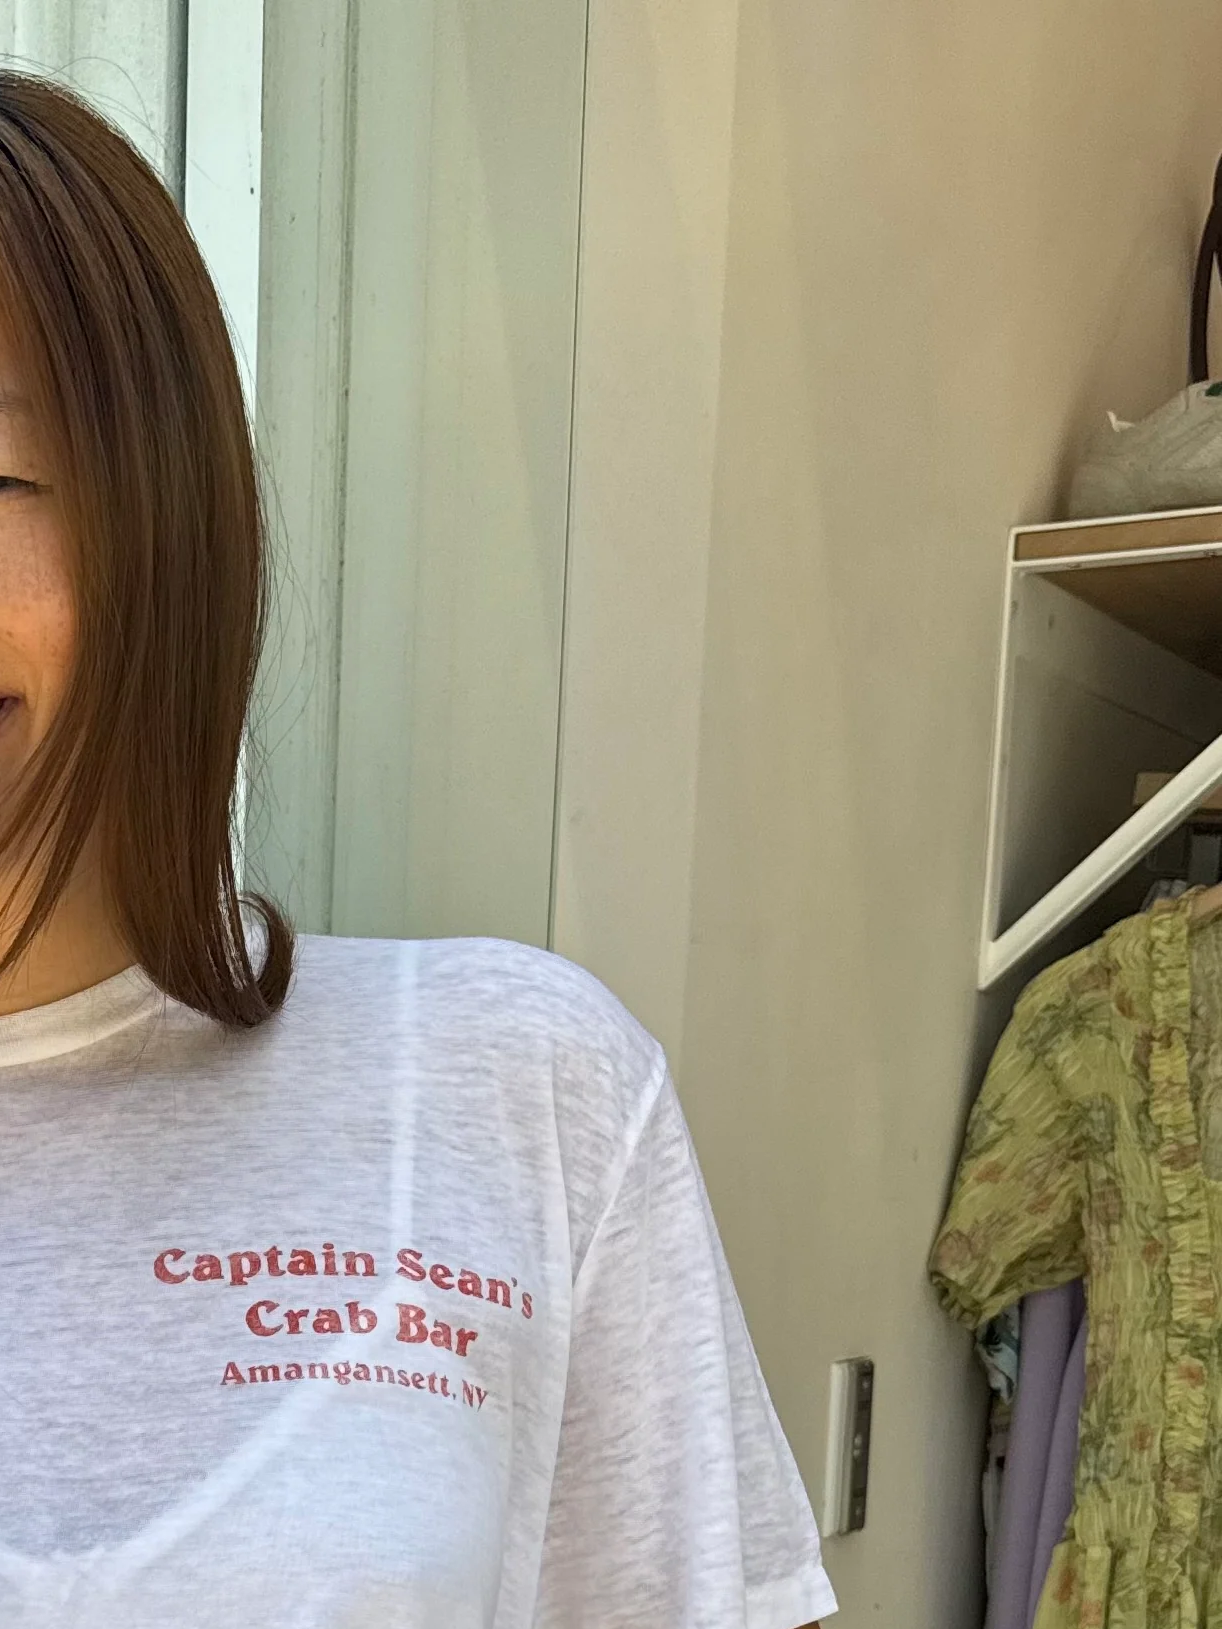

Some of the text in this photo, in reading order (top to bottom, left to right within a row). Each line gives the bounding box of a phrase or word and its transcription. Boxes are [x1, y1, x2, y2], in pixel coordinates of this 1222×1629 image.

[153, 1242, 533, 1319] Captain Sean's
[245, 1300, 478, 1357] Crab Bar
[462, 1379, 488, 1412] NY
